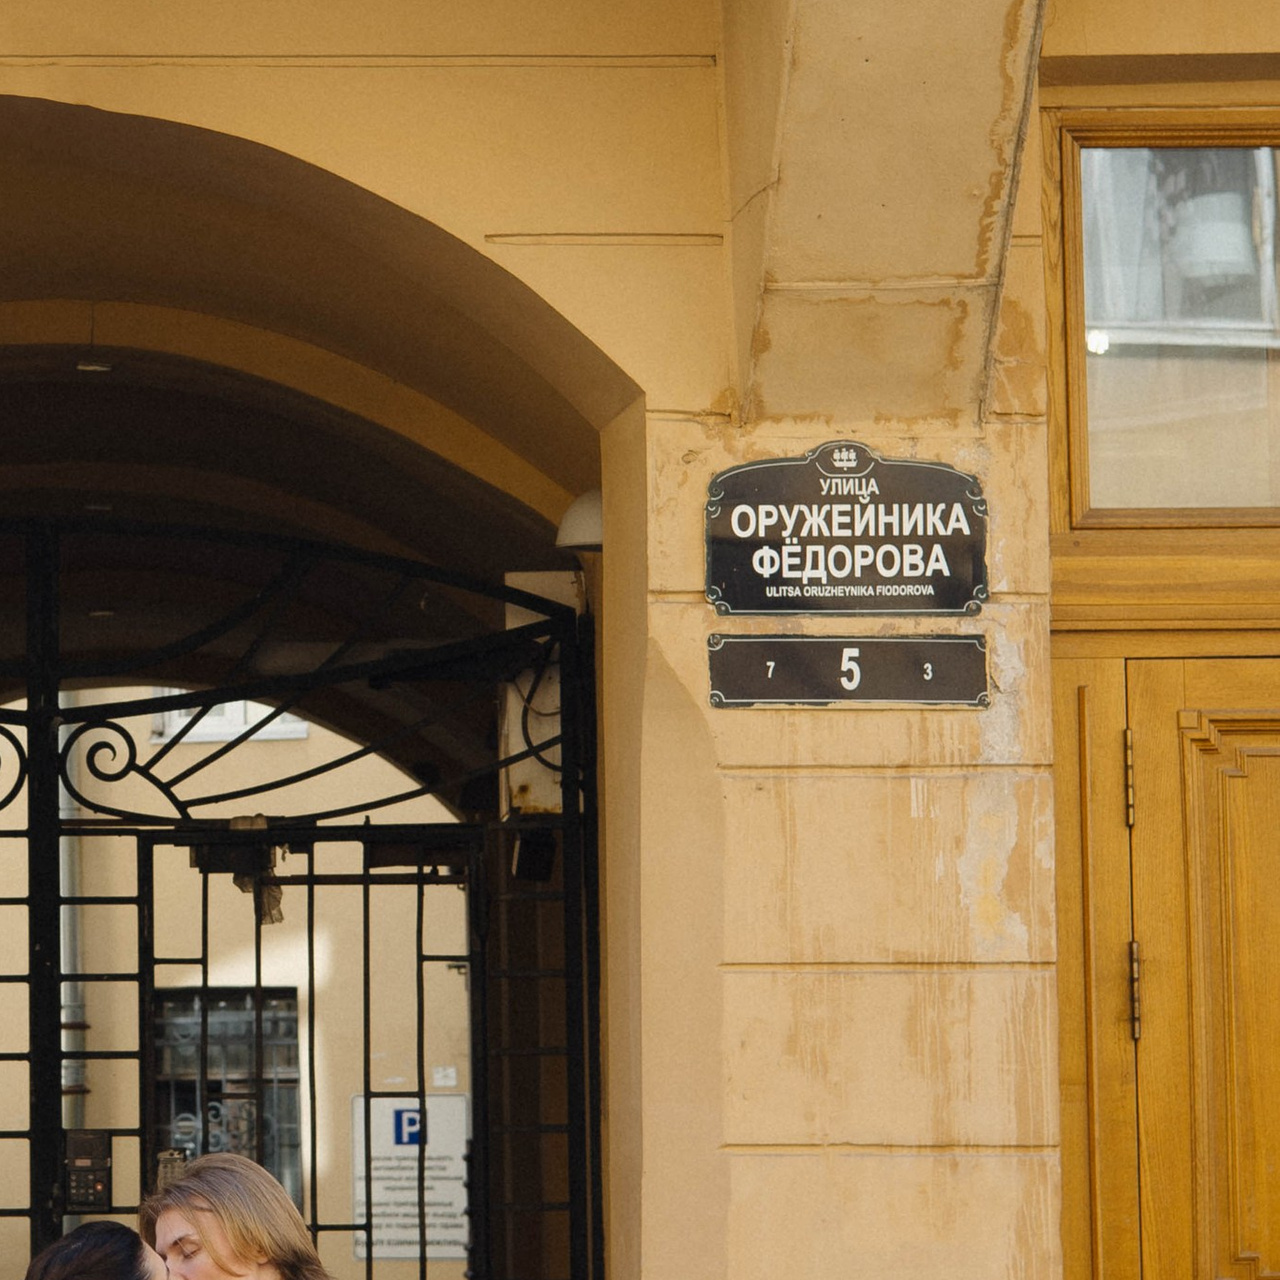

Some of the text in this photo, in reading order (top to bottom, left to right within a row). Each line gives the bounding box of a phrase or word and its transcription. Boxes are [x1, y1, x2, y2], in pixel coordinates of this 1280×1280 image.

[820, 478, 879, 497] УЛИЦА
[730, 495, 971, 538] ОРУЖЕЙНИКА
[752, 537, 951, 584] ФЁДОРОВА
[766, 584, 935, 597] ULITSA ORUZHEYNIKA FIODOROVA
[766, 648, 933, 691] 7 5 3
